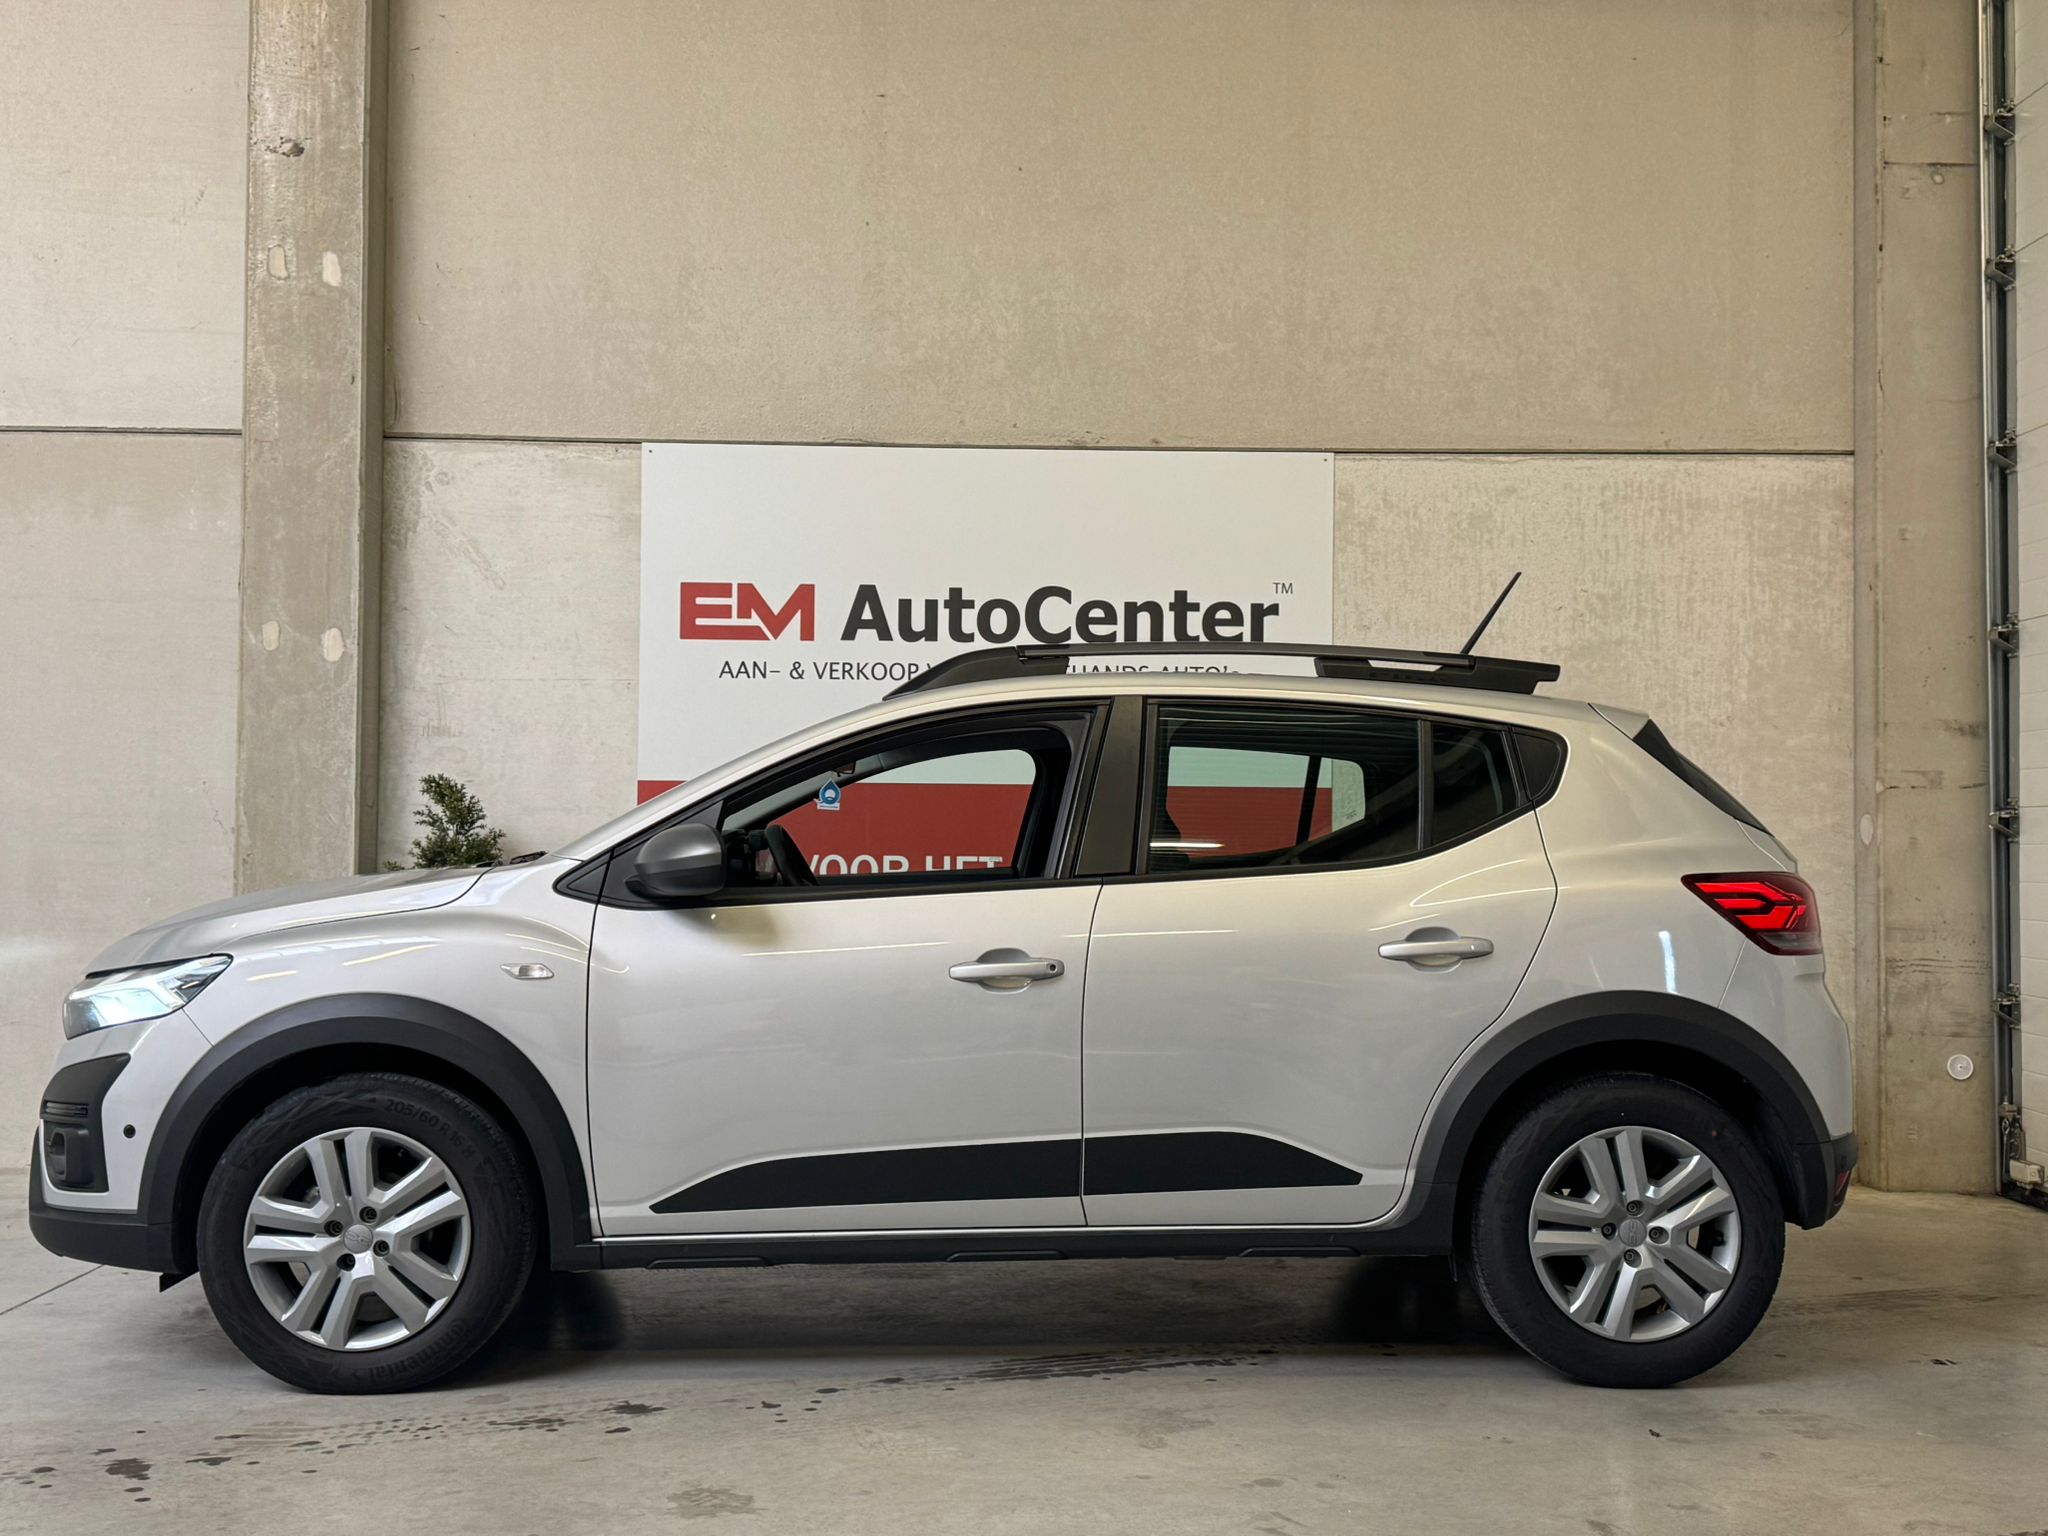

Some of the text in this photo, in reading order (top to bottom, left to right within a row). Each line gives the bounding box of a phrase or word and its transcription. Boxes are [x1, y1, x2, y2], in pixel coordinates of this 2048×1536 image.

[680, 582, 1294, 644] EM AutoCenter TM
[789, 661, 805, 680] &
[813, 661, 920, 681] VERKOOP
[384, 1098, 440, 1128] 205/60
